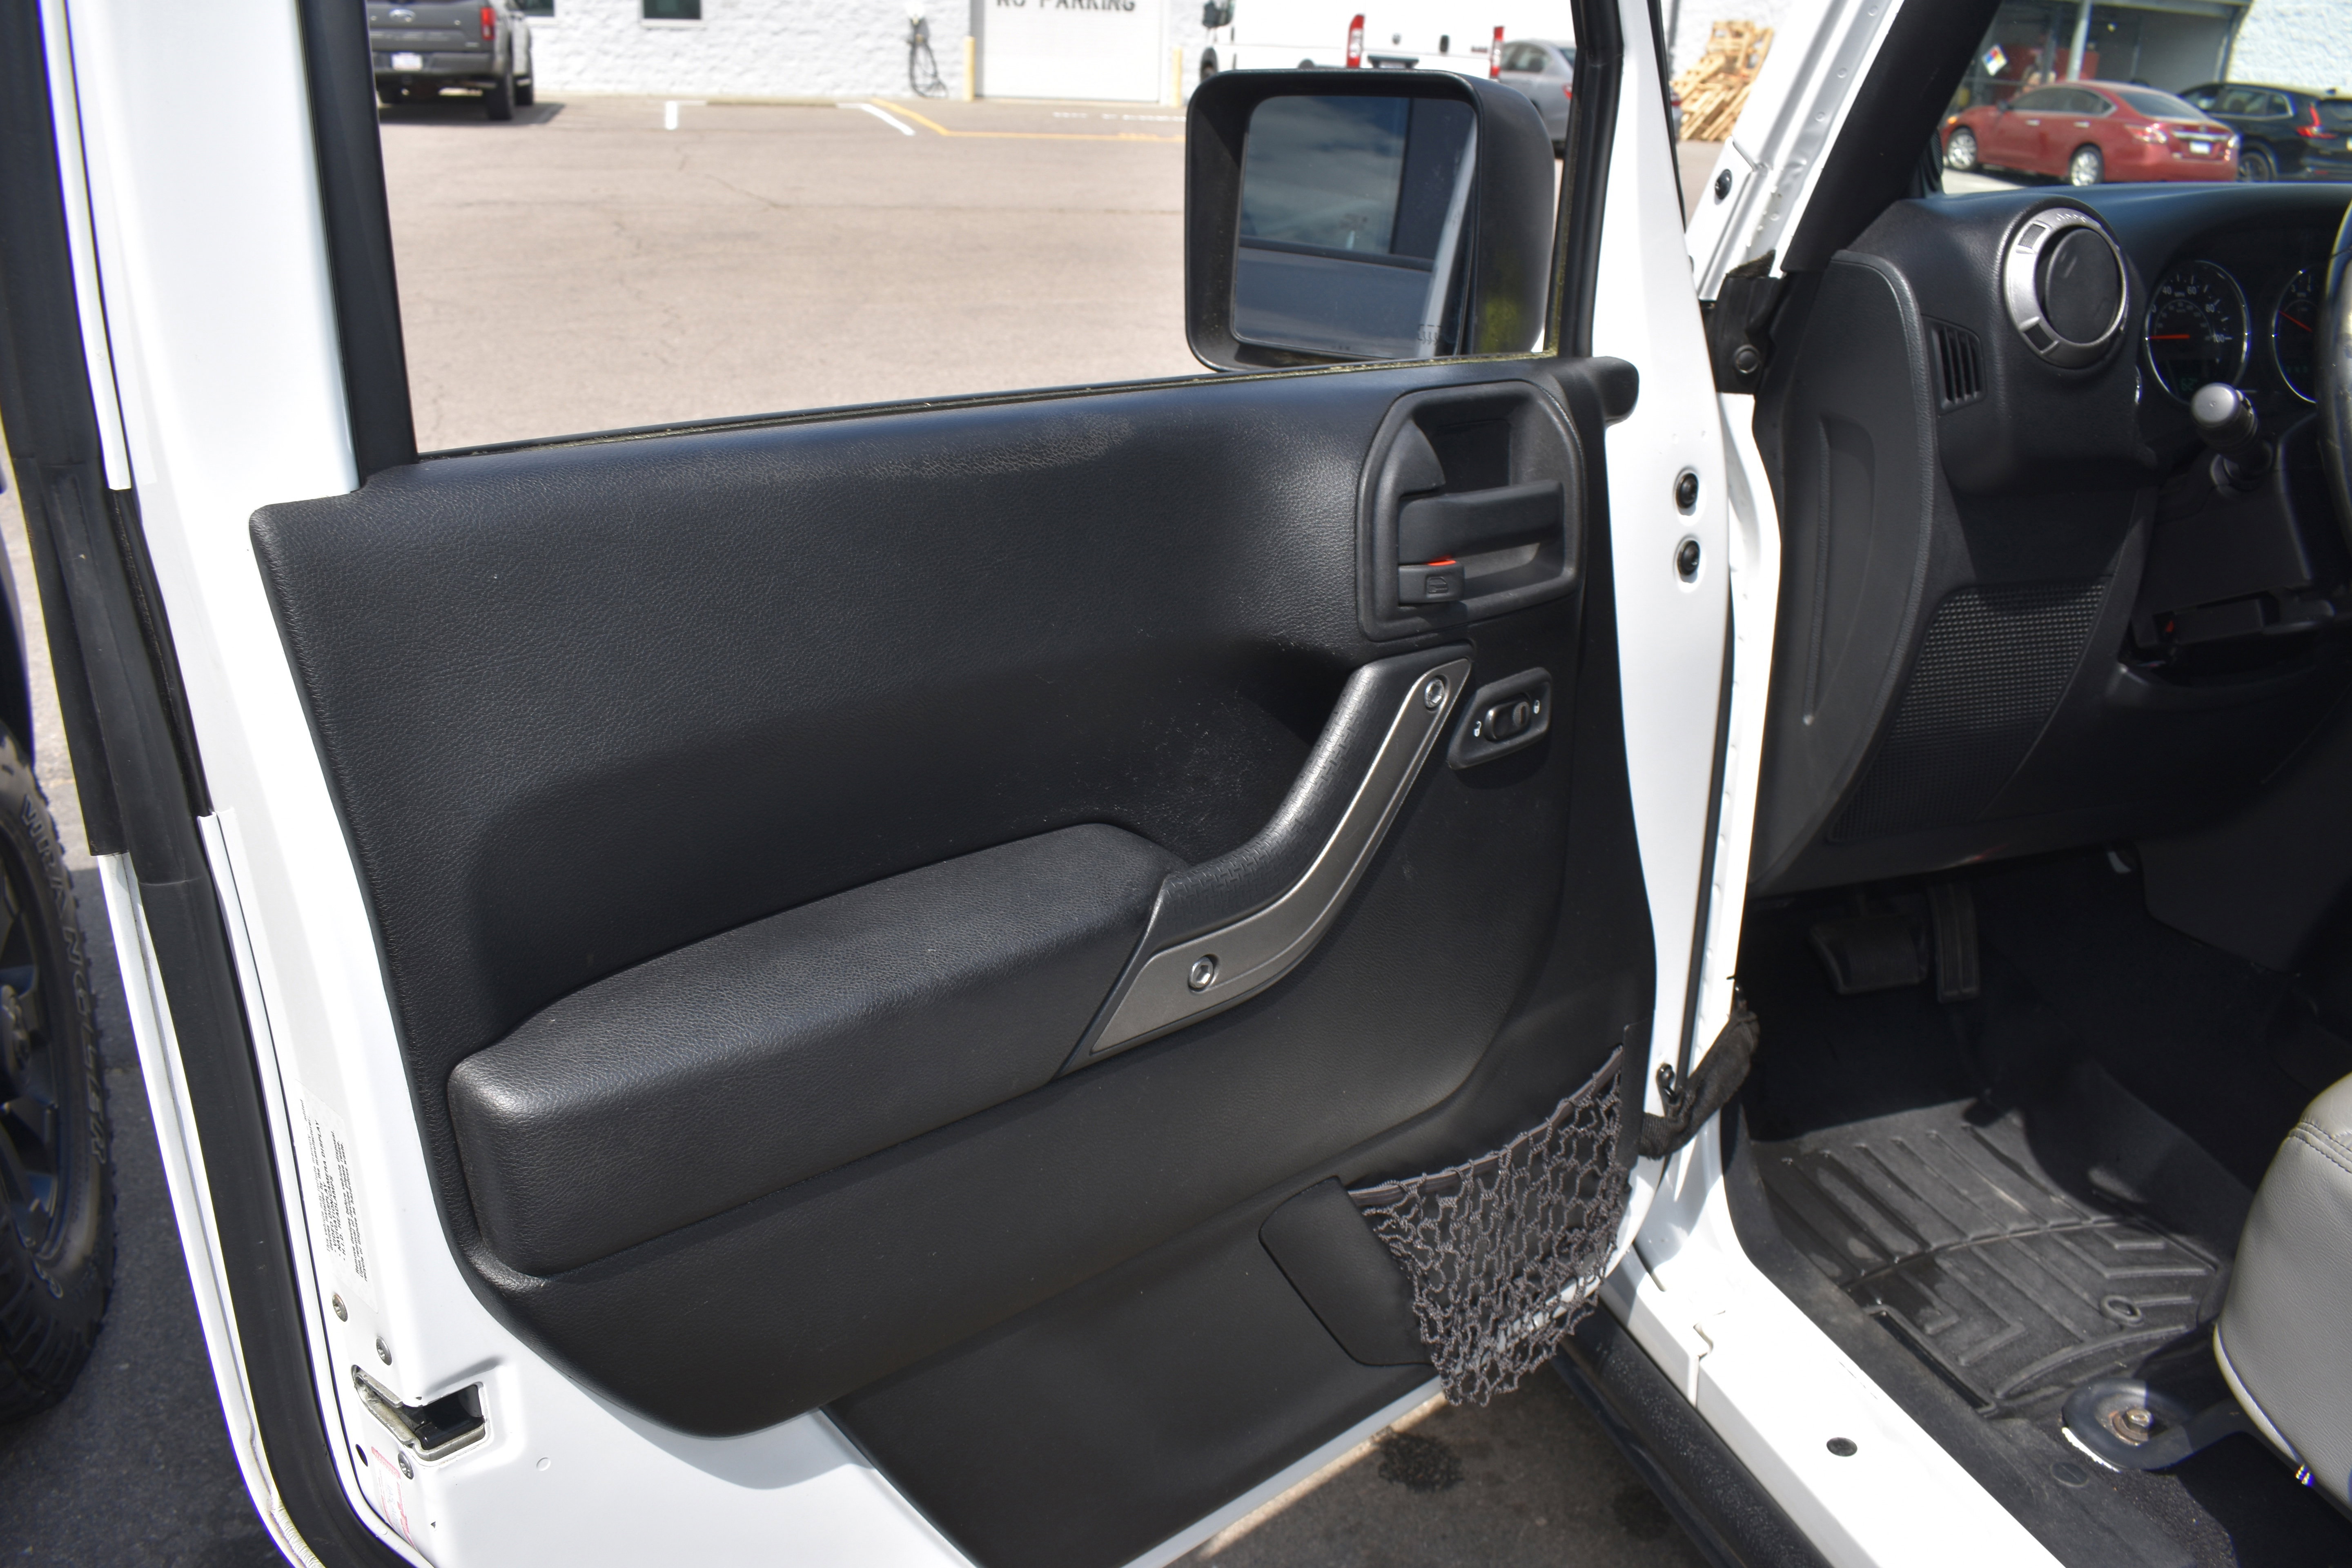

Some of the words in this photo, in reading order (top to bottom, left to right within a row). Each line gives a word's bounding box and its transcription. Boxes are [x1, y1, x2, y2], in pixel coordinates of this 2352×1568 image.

[2163, 286, 2172, 295] 40
[2187, 286, 2197, 295] 60
[315, 1120, 325, 1158] DISPLAY
[331, 1131, 340, 1162] disposal.
[323, 1182, 332, 1219] DISPLAY
[329, 1175, 341, 1229] HEADLAMPS
[345, 1167, 354, 1204] hazardous
[323, 1161, 341, 1251] NAVIGATION/CAMERA
[352, 1228, 360, 1257] removal
